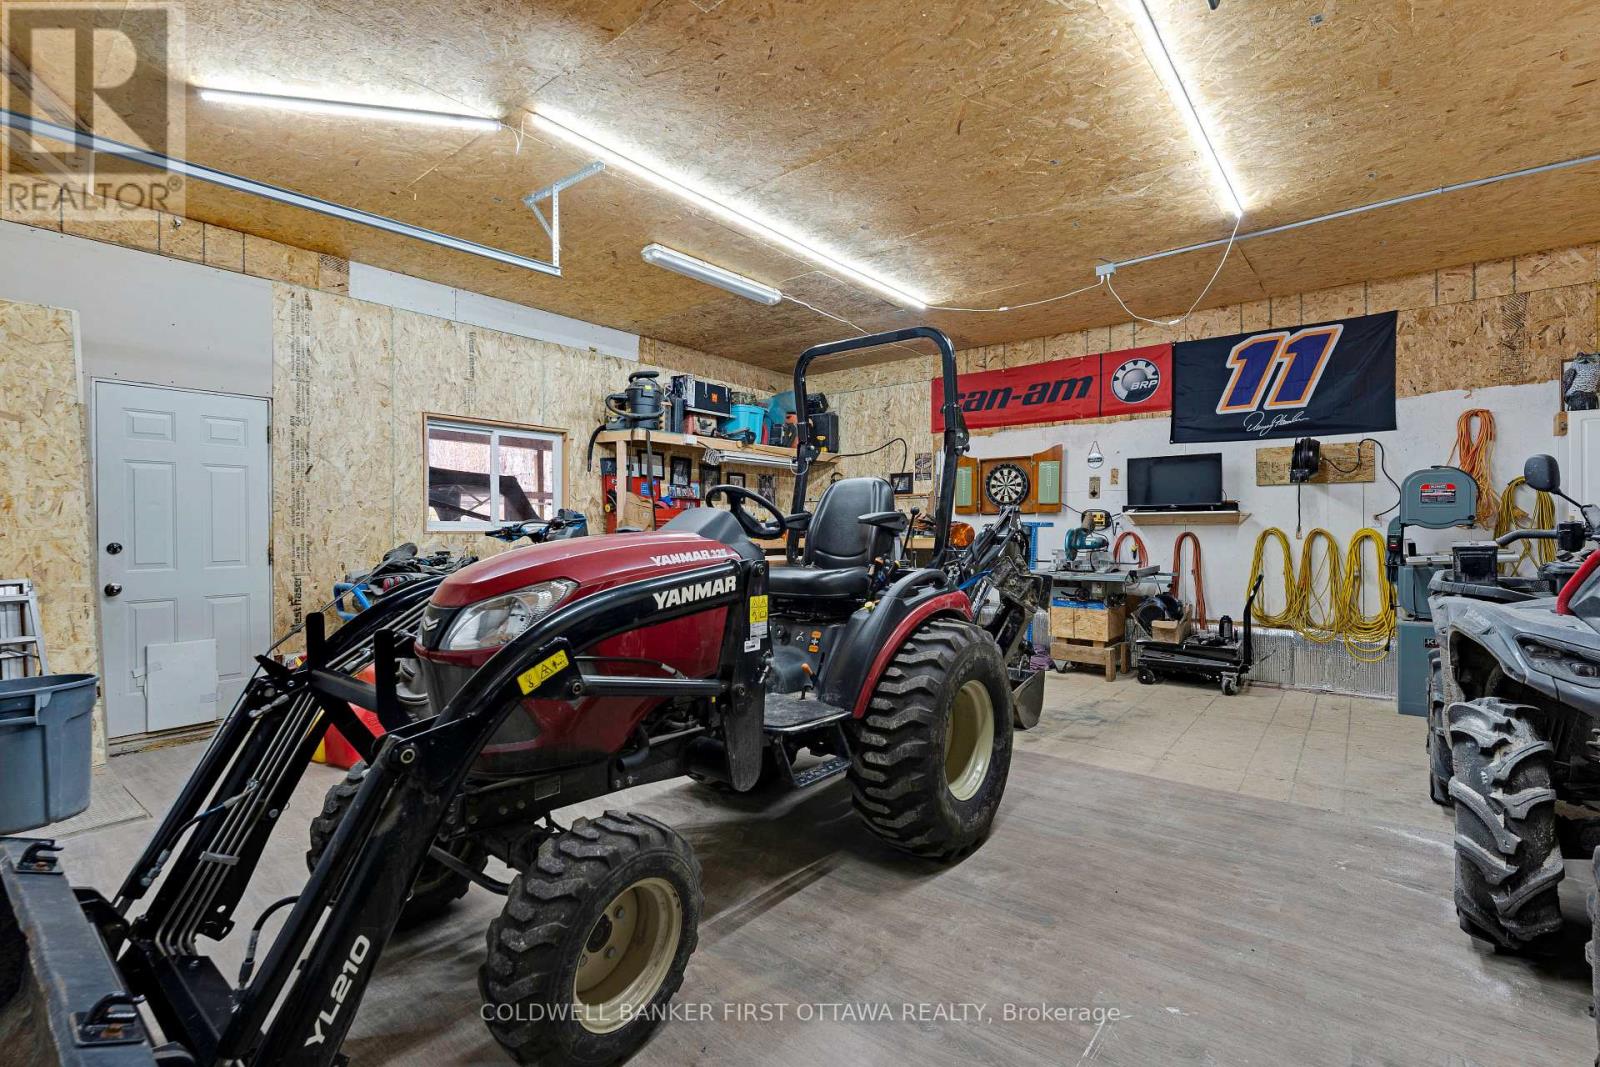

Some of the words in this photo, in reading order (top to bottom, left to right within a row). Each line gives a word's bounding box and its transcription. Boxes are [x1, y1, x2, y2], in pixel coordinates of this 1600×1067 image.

[1131, 379, 1158, 390] BRP
[1216, 324, 1344, 415] 11
[649, 550, 710, 567] YANMAR
[652, 575, 737, 610] YANMAR
[304, 934, 371, 1047] YL210
